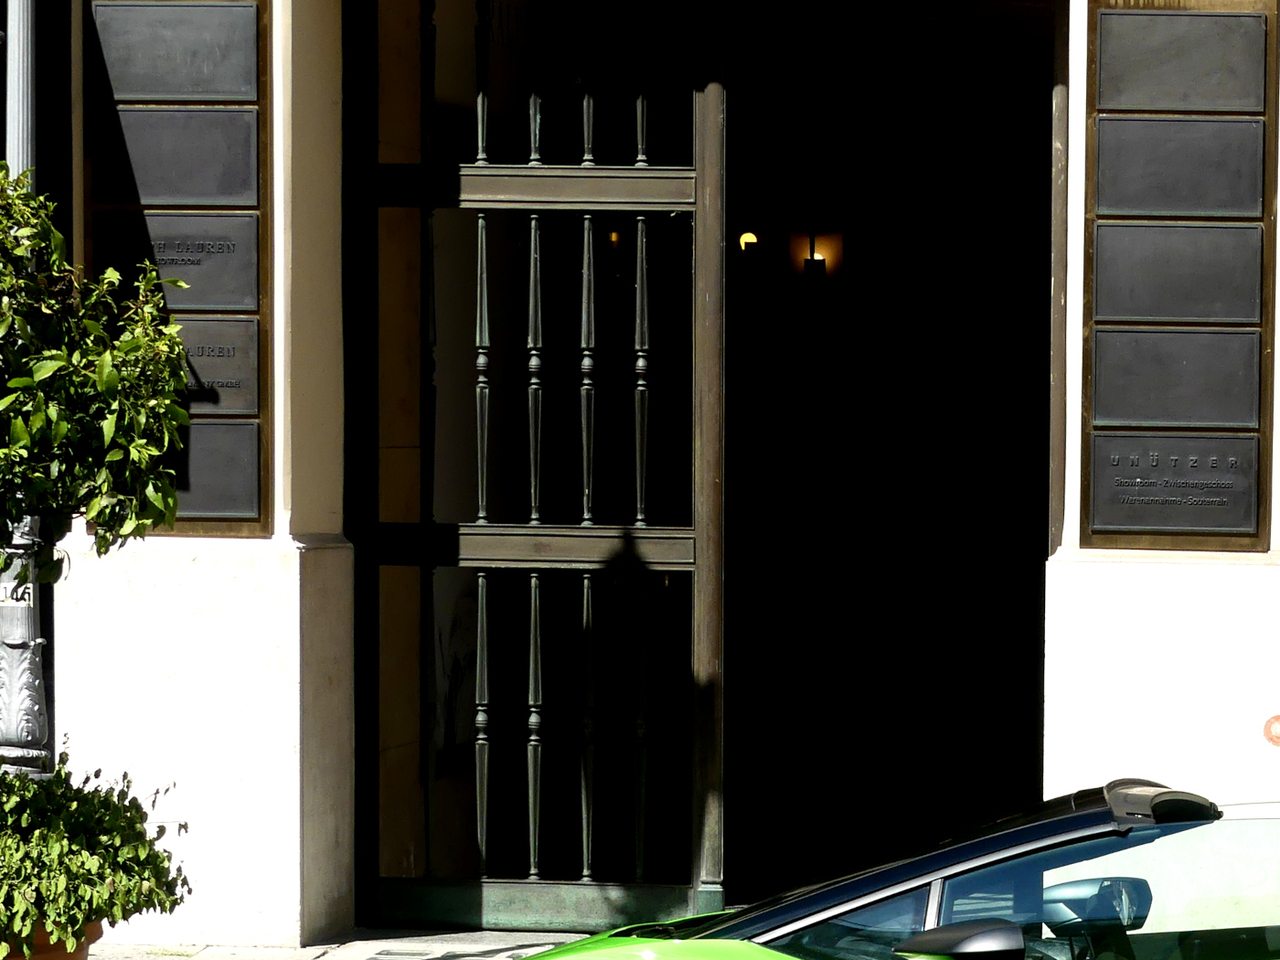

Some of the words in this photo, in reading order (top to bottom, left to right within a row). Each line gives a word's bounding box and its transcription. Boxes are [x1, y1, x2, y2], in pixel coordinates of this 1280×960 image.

[175, 241, 236, 254] LAUREN
[184, 345, 236, 358] AUREN
[1114, 477, 1157, 488] Showroom
[1187, 496, 1229, 506] Souterrain
